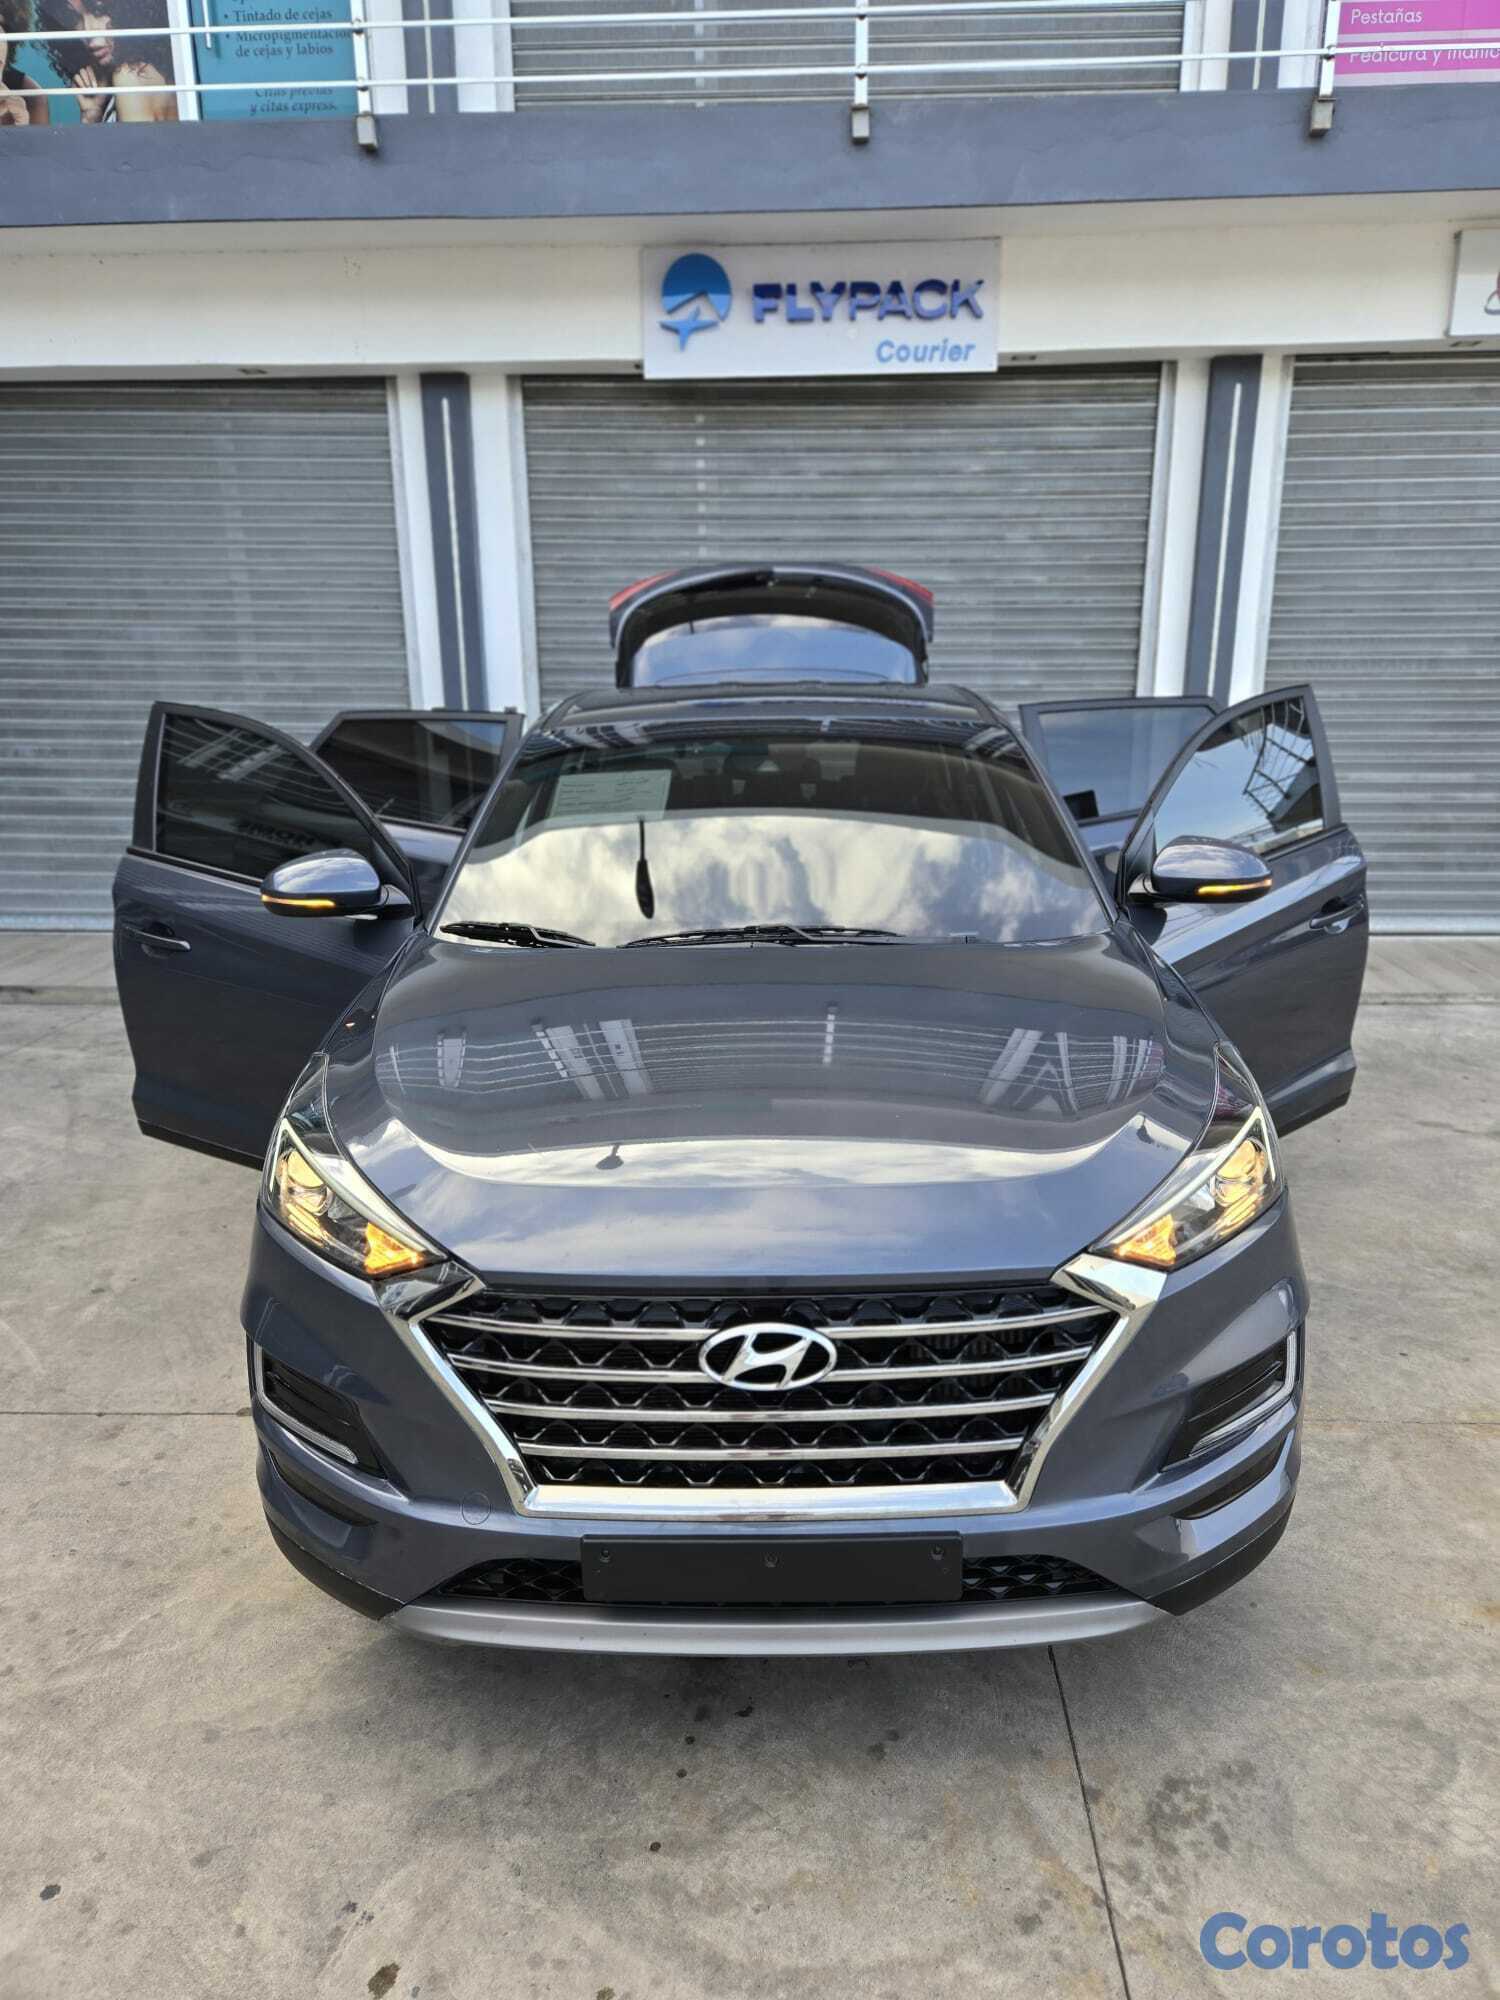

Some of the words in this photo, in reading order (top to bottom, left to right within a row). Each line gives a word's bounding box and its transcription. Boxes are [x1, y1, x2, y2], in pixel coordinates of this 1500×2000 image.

[232, 9, 281, 22] Tintado
[284, 8, 299, 20] de
[302, 8, 333, 22] cejas
[1351, 8, 1423, 25] Pestañas
[235, 44, 250, 57] de
[253, 43, 282, 58] cejas
[284, 46, 292, 58] y
[296, 43, 334, 56] labios
[1432, 49, 1442, 66] y
[752, 279, 985, 323] FLYPACK
[876, 338, 976, 364] Courier
